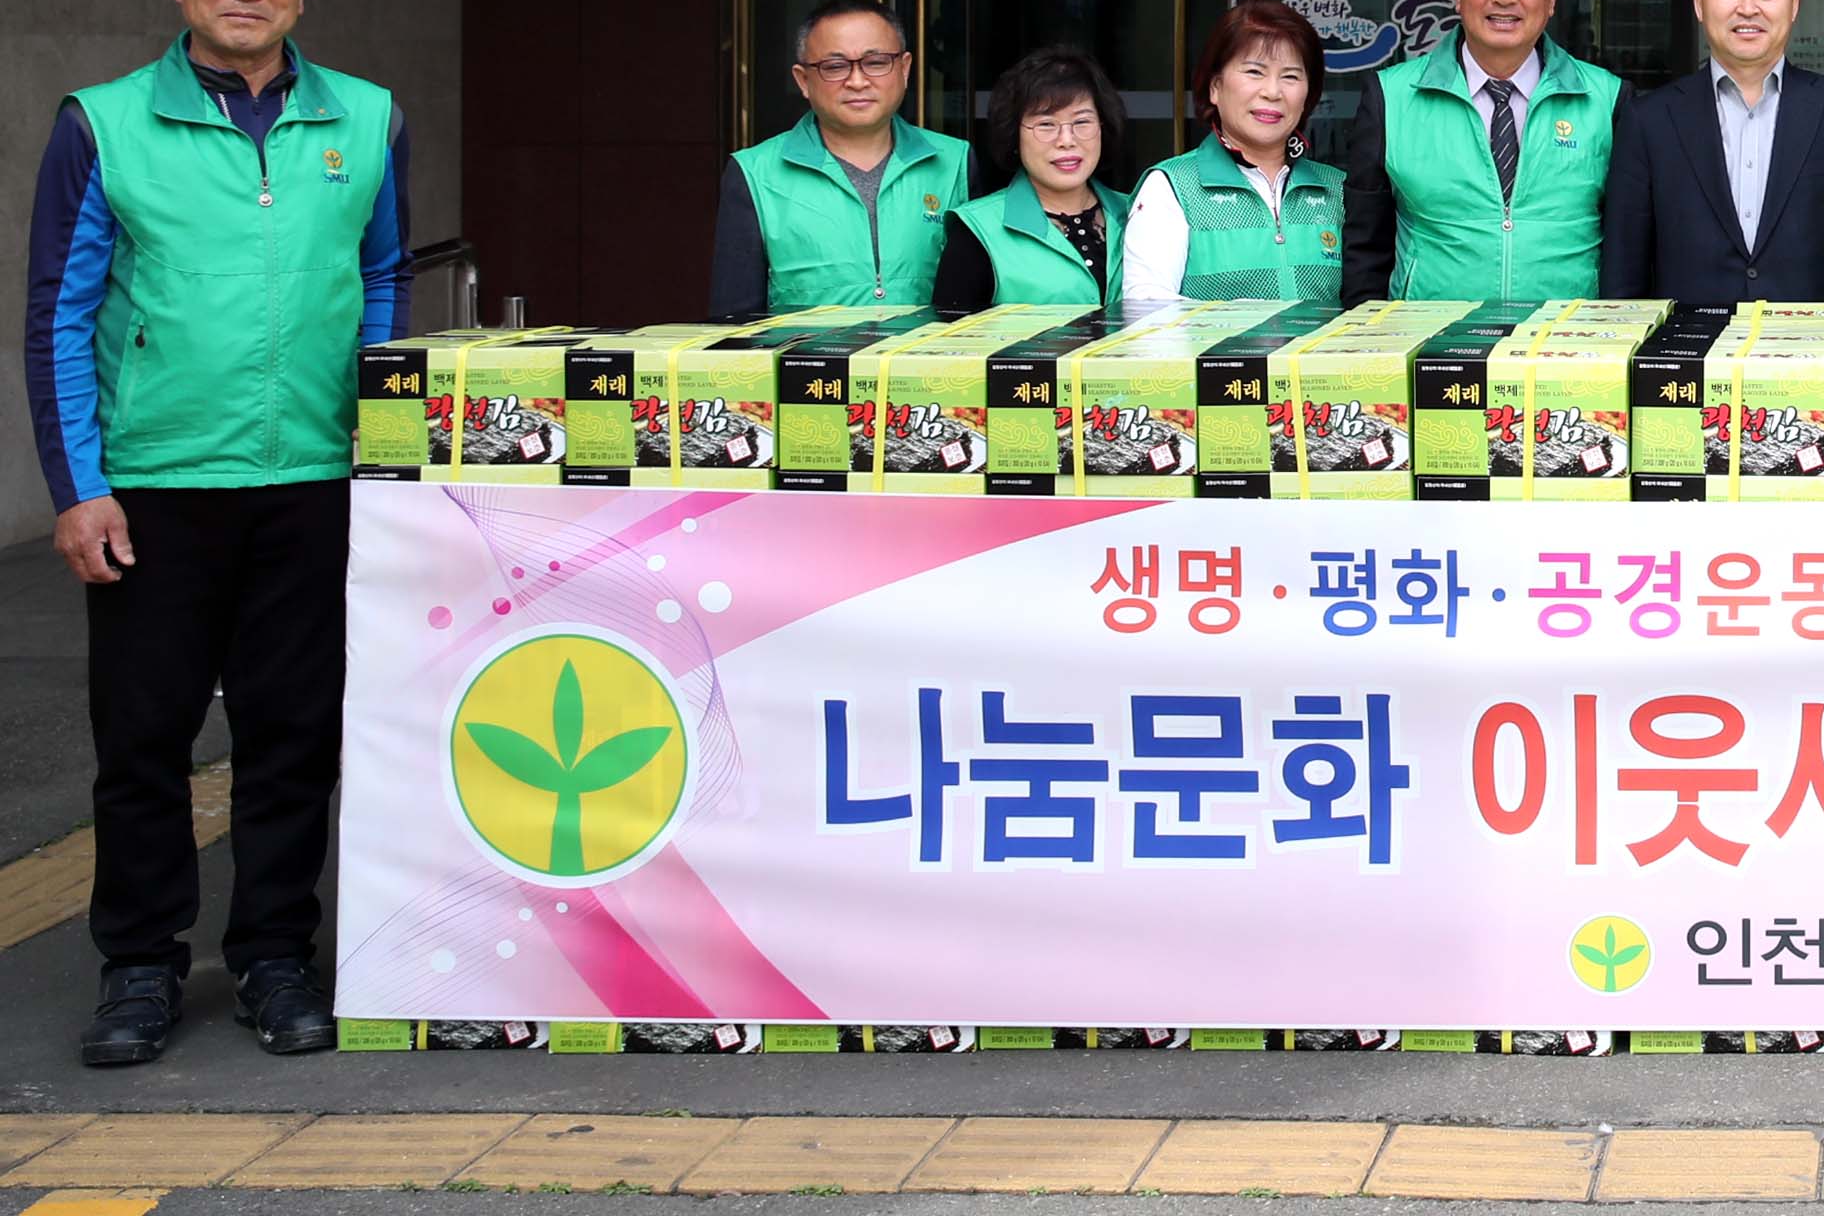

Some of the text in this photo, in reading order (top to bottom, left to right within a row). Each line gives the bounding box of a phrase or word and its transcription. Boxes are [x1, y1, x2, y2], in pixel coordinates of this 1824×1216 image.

[1554, 138, 1577, 149] SMU
[383, 372, 420, 395] 재래
[590, 374, 627, 396] 재래
[640, 375, 664, 388] 백제
[804, 378, 842, 401] 재래
[1013, 381, 1050, 404] 재래
[1224, 378, 1261, 401] 재래
[1494, 384, 1518, 397] 백제
[1659, 381, 1697, 404] 재래
[1442, 382, 1480, 406] 재래
[825, 689, 1409, 864] 나눔문화
